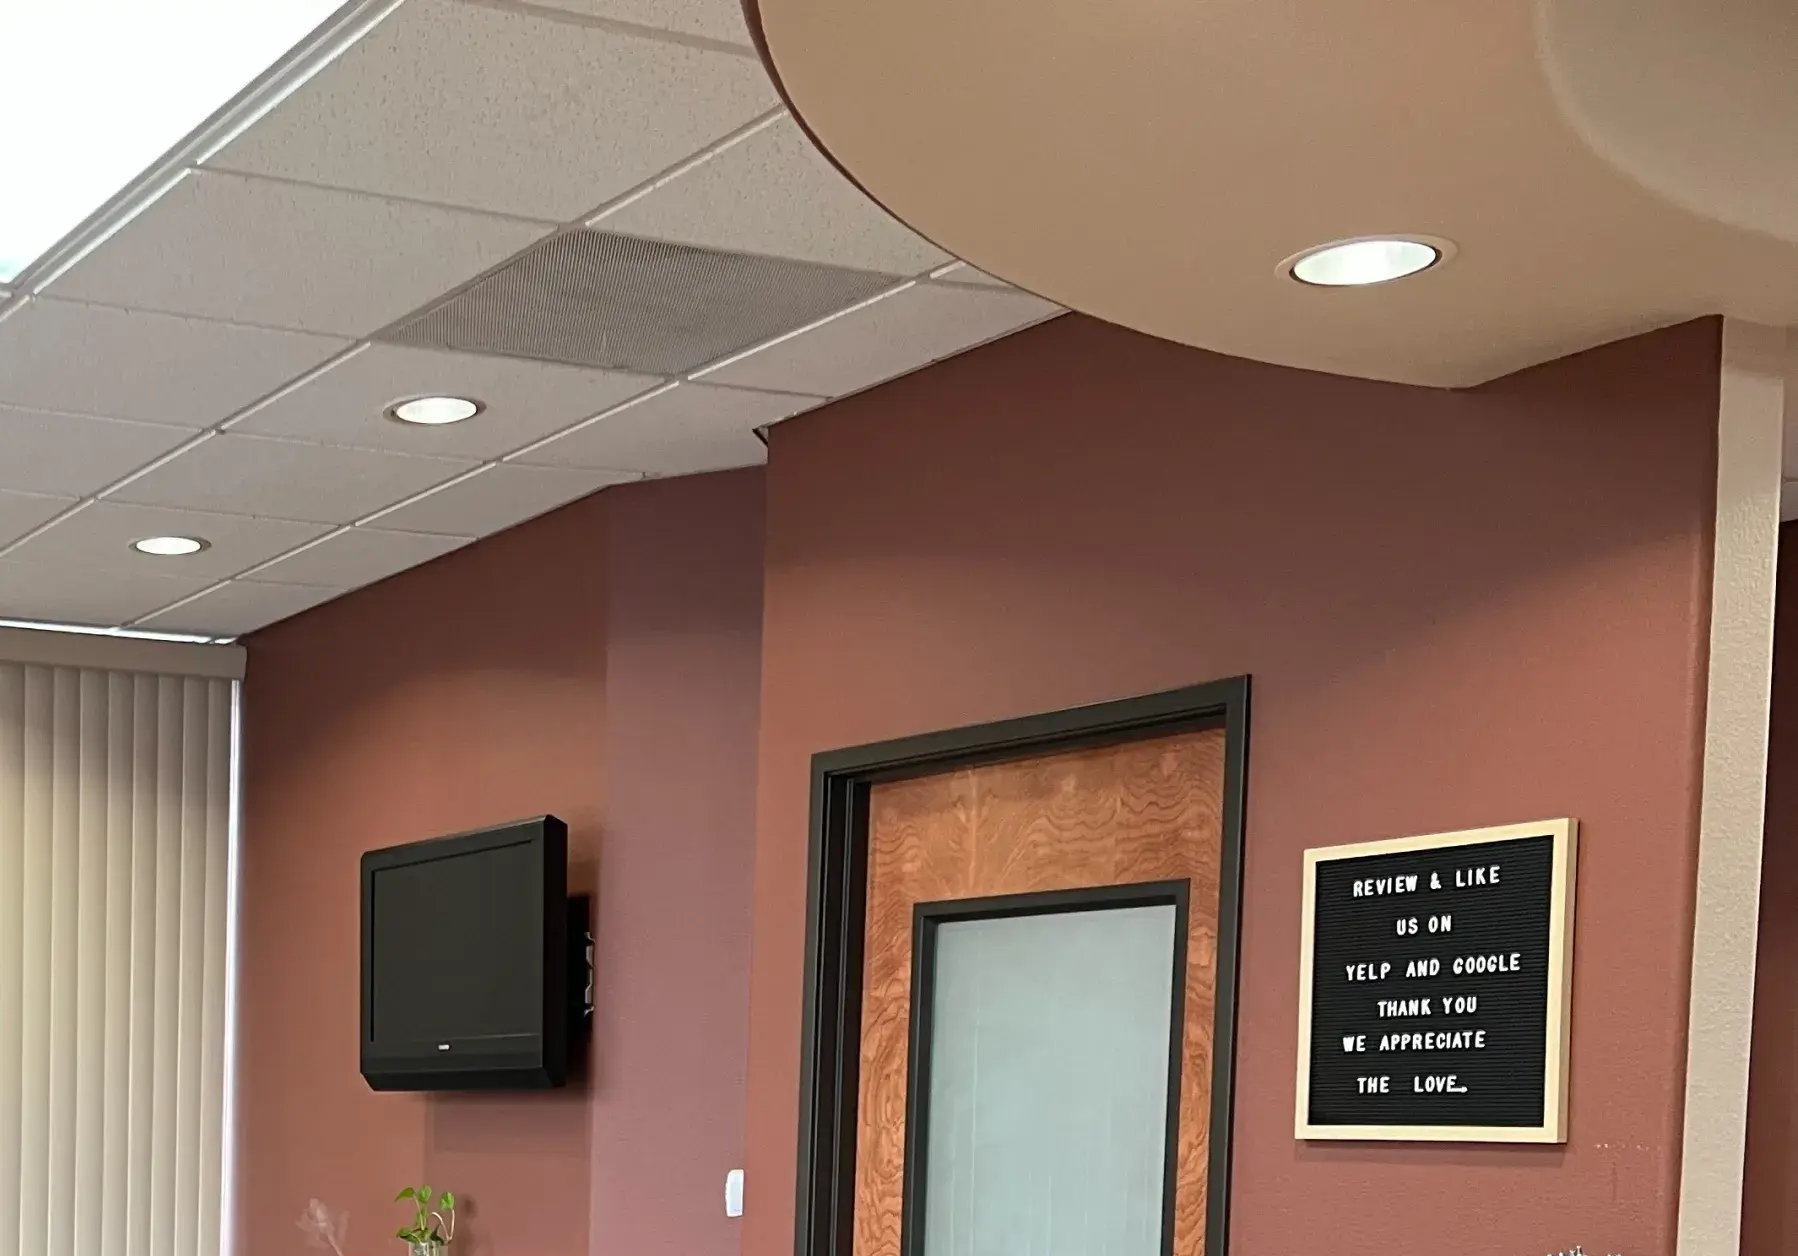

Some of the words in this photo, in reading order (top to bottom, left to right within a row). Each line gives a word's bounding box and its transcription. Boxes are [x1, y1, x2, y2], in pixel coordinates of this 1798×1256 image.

[1353, 874, 1418, 898] REVIEW
[1429, 871, 1442, 890] &
[1455, 865, 1501, 888] LIKE
[1396, 916, 1419, 936] US
[1427, 914, 1452, 933] ON
[1345, 962, 1391, 982] YELP
[1405, 957, 1440, 978] AND
[1452, 952, 1521, 975] GOOGLE
[1377, 998, 1432, 1018] THANK
[1442, 996, 1477, 1015] YOU
[1342, 1034, 1367, 1053] WE
[1379, 1030, 1487, 1052] APPRECIATE
[1356, 1075, 1390, 1095] THE
